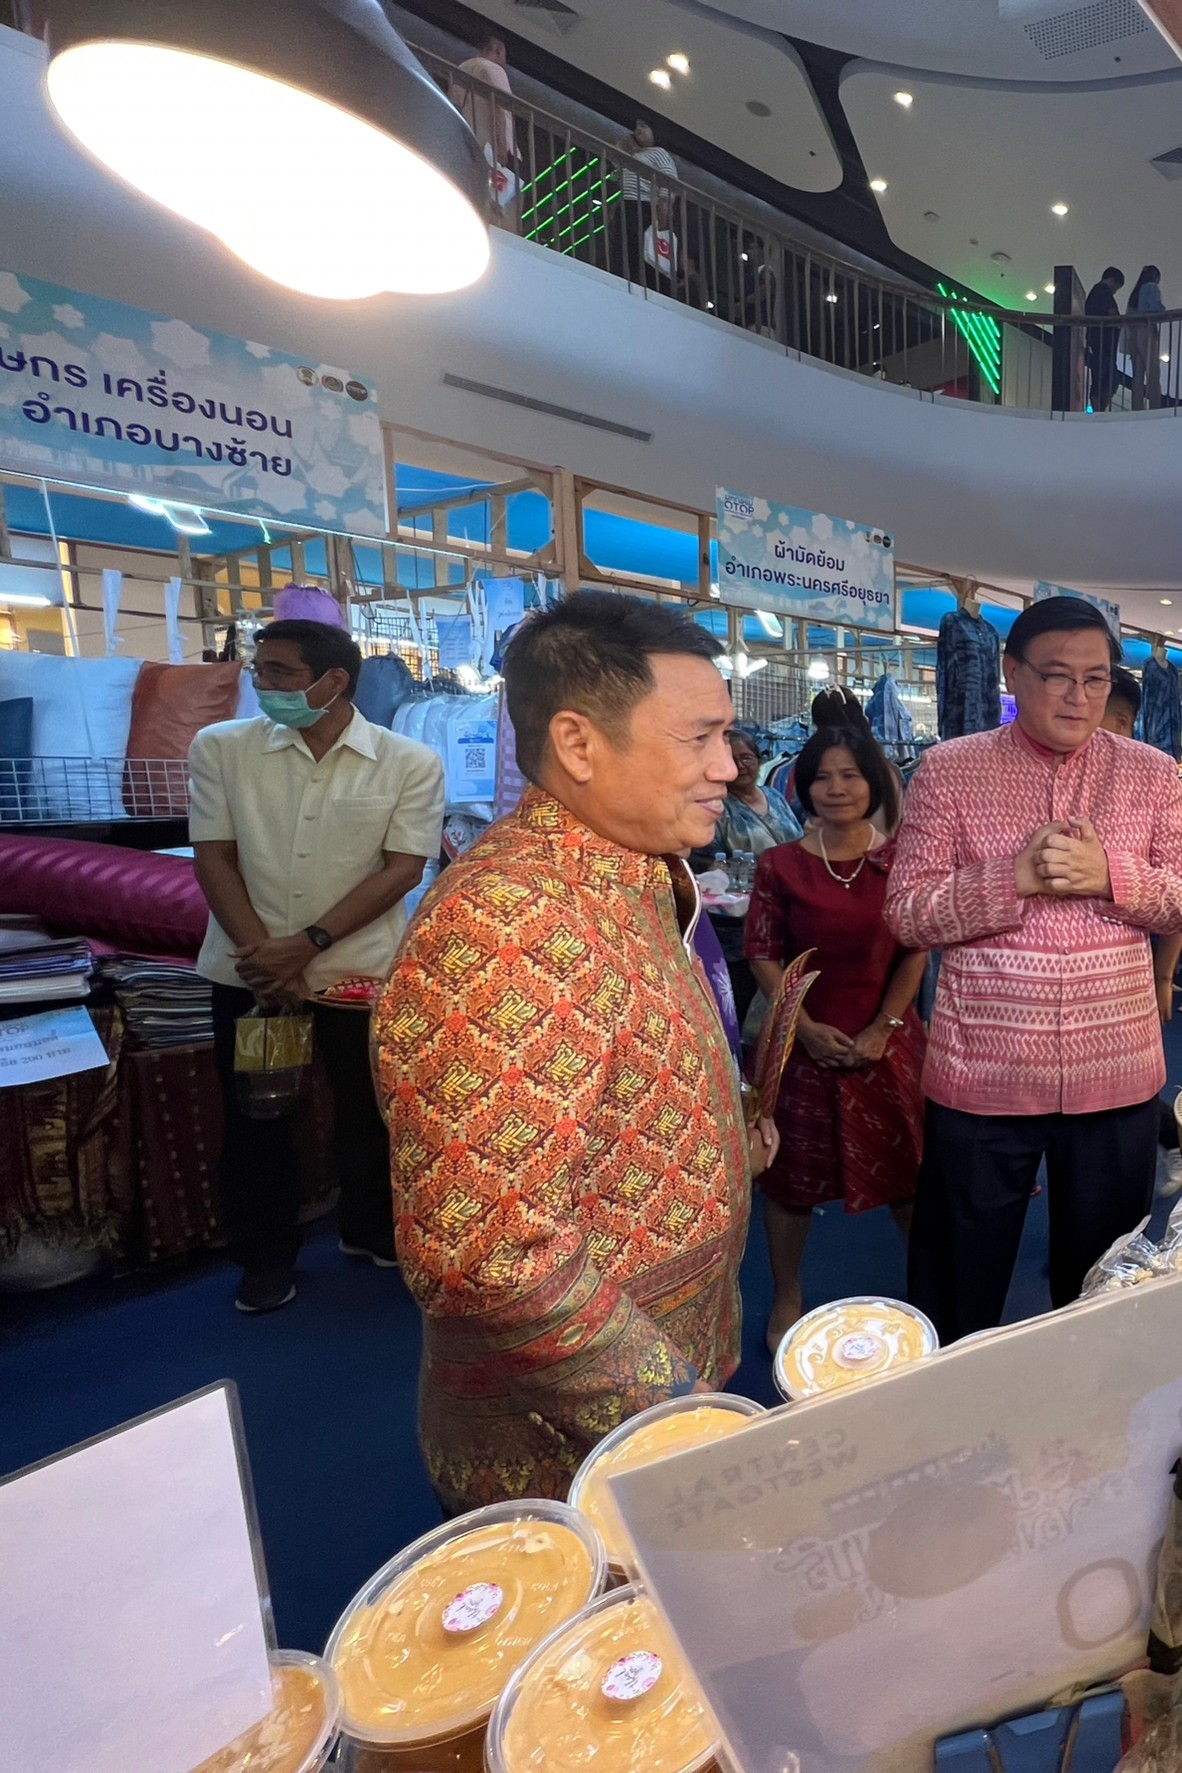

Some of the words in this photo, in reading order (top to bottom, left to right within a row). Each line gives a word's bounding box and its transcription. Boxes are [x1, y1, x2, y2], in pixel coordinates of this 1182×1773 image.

[0, 347, 88, 389] ษกร
[103, 369, 293, 439] เครื่องนอน
[22, 392, 292, 477] อำเภอบางซ้าย
[725, 556, 890, 606] อำเภอพระนครศรีอยุธยา
[774, 540, 845, 572] ผ้ามัดย้อม
